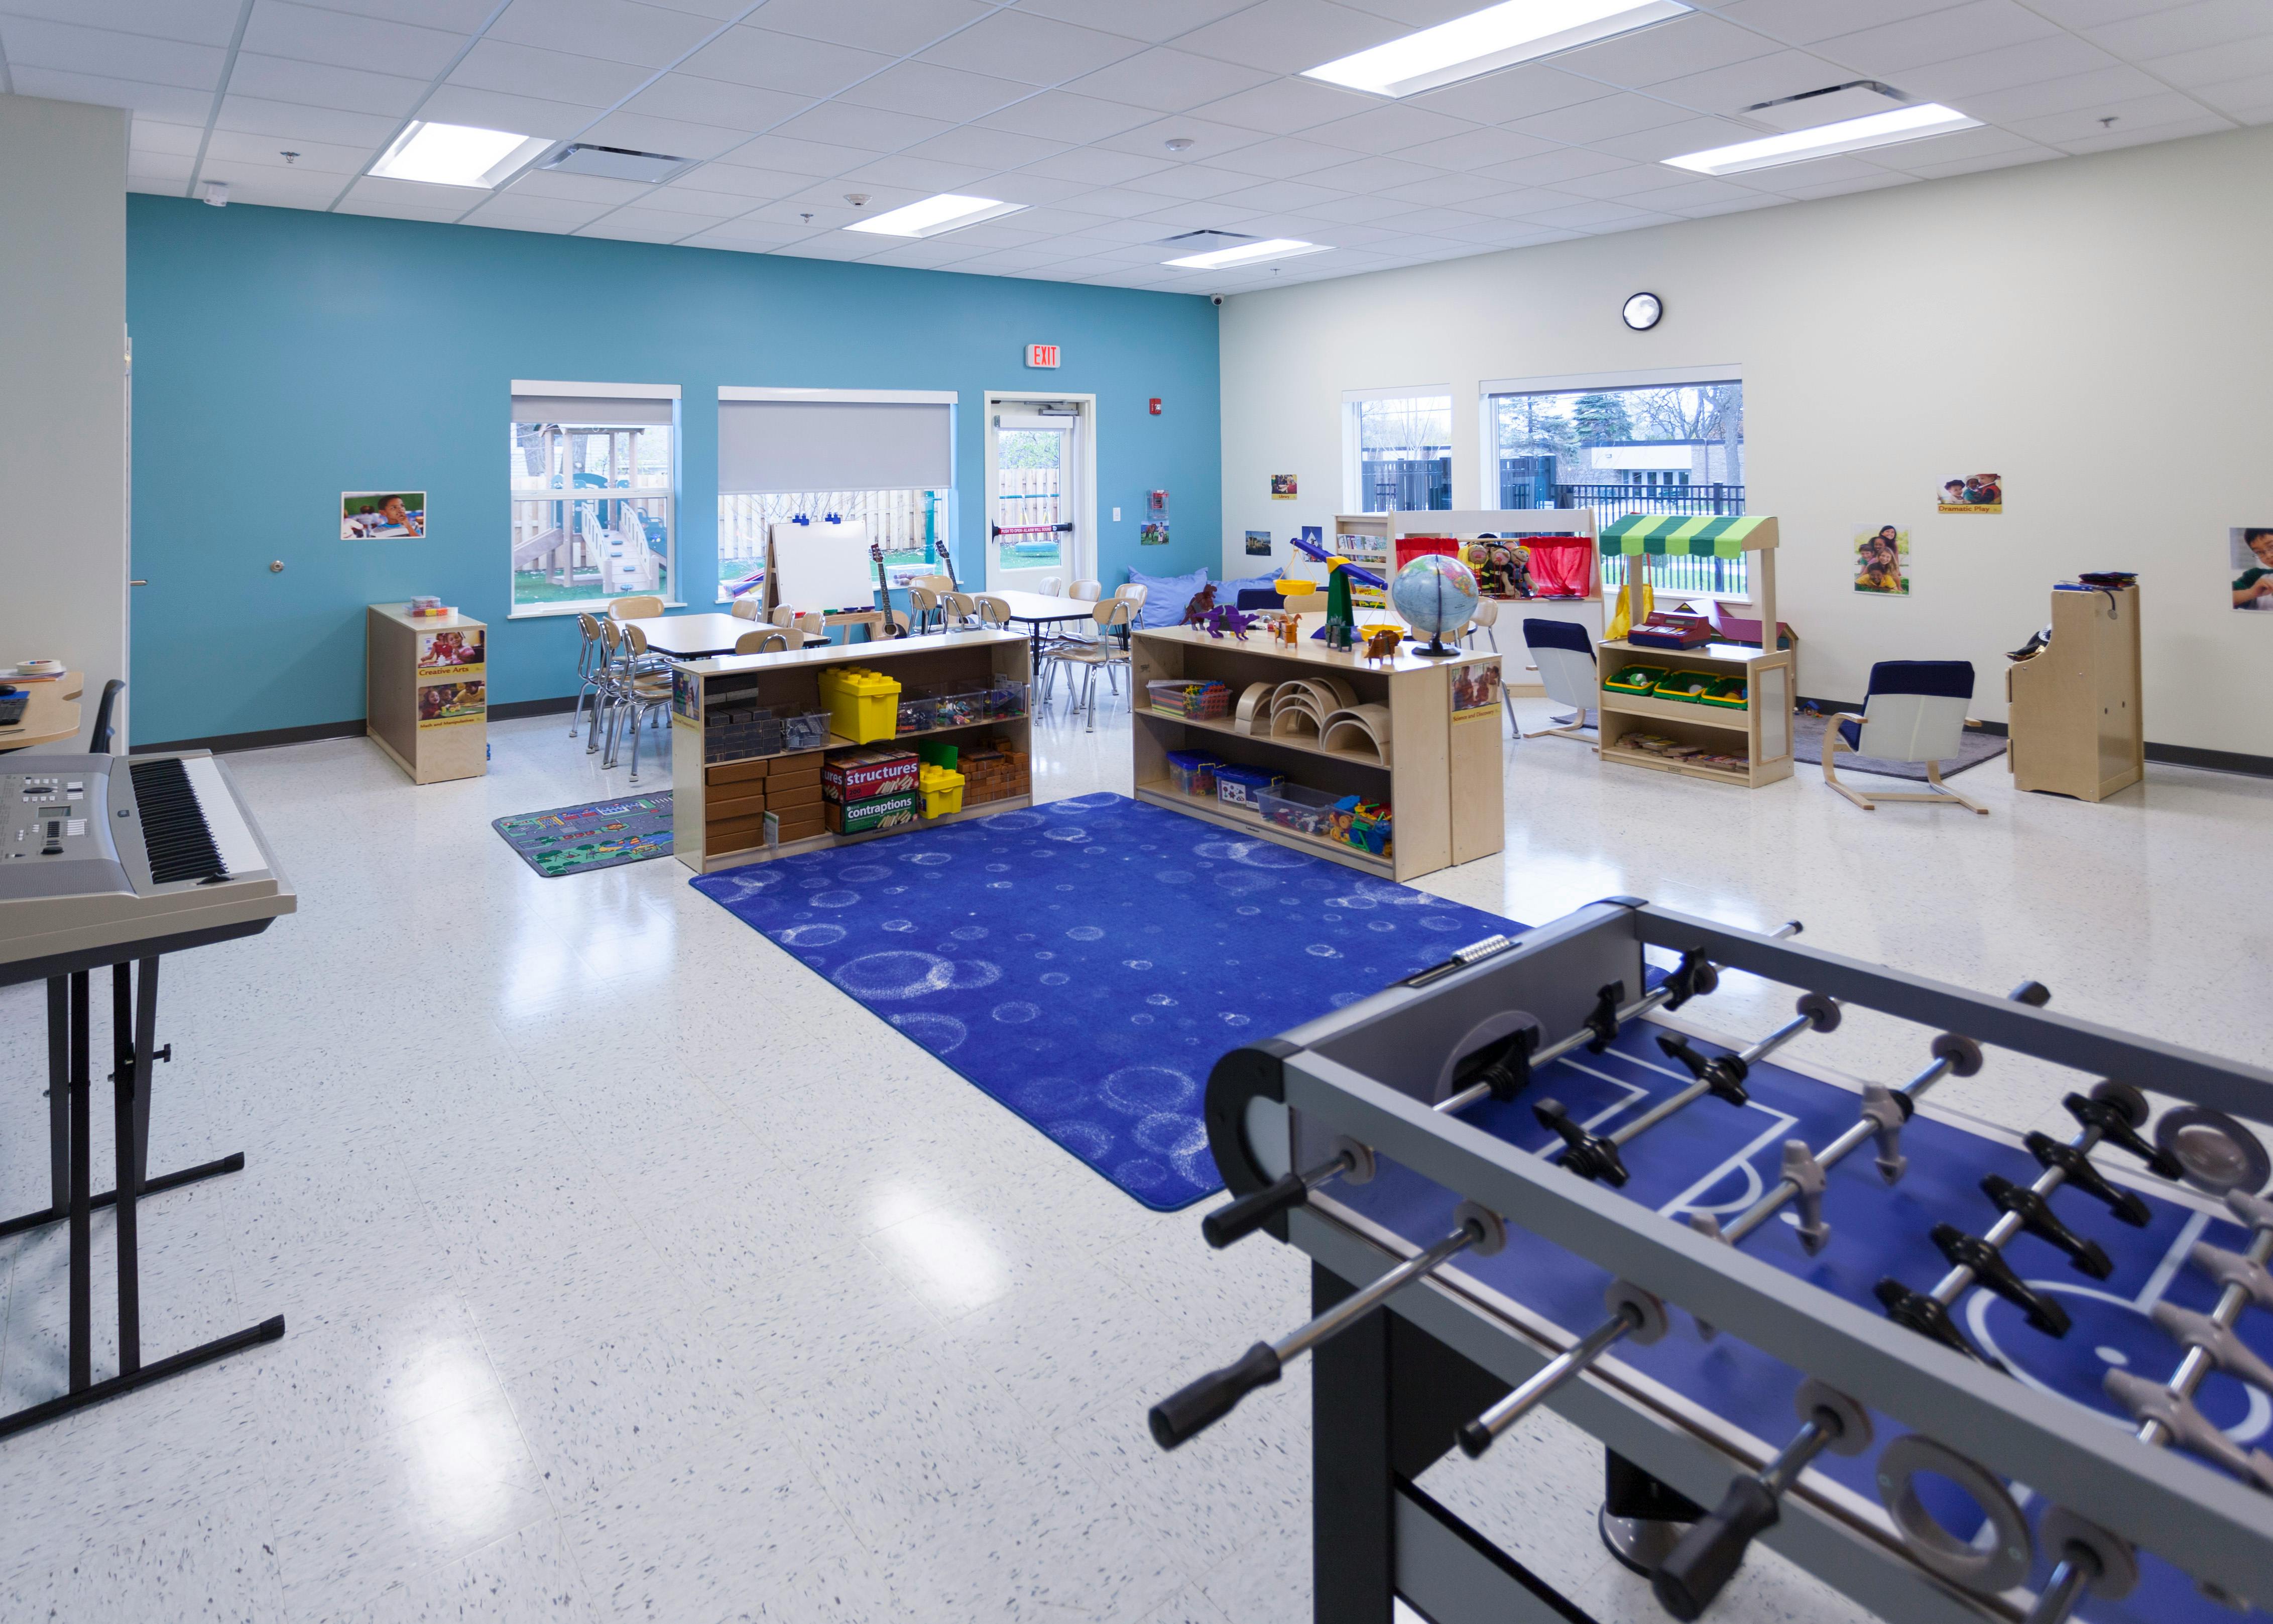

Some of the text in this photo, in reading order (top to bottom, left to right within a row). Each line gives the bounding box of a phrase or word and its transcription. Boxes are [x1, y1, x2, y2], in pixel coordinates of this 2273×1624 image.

[1034, 345, 1056, 366] EXIT
[419, 668, 450, 676] Creative
[847, 763, 917, 785] structures
[848, 798, 912, 819] contraptions
